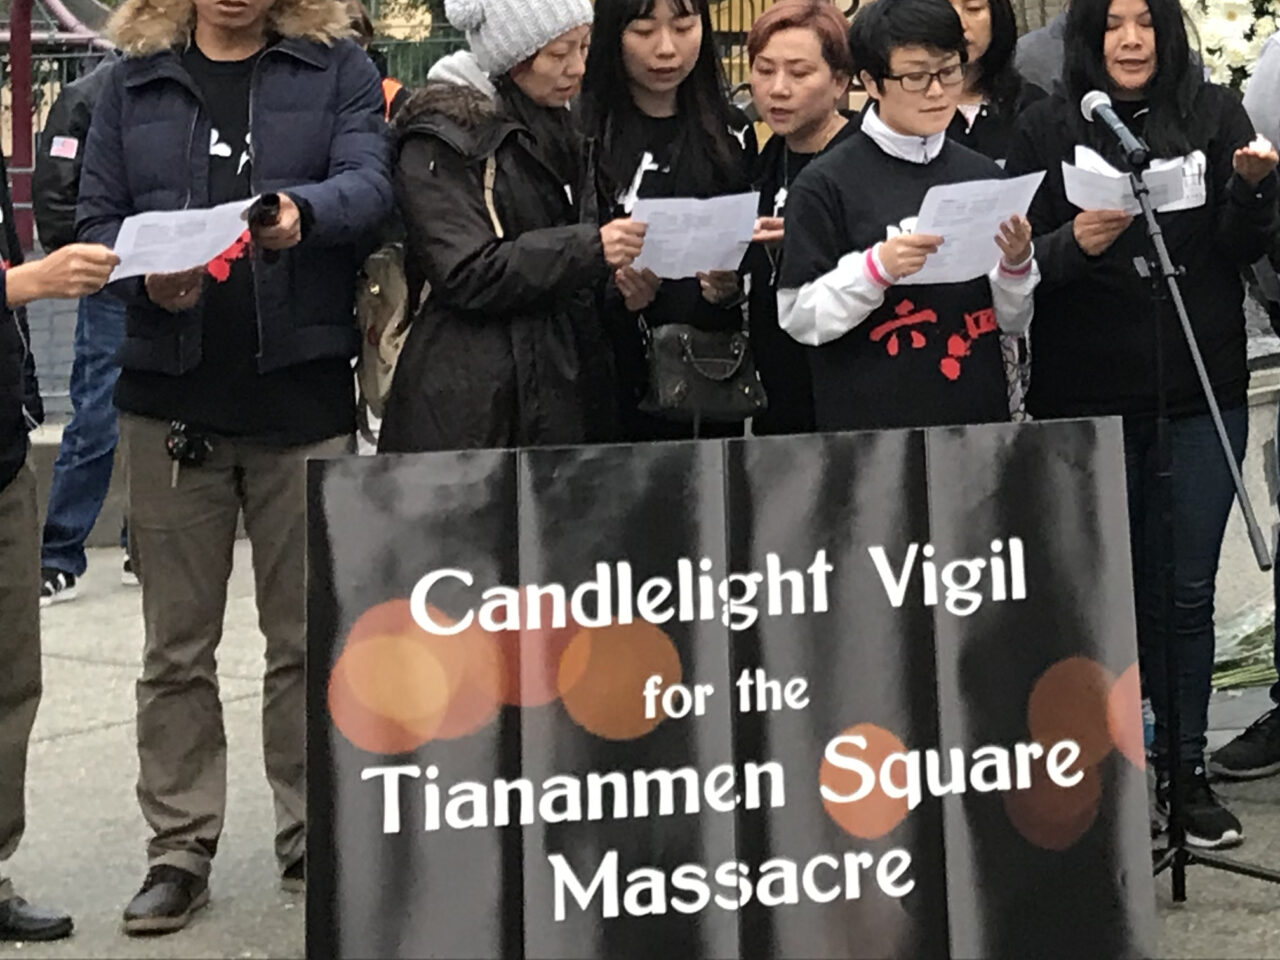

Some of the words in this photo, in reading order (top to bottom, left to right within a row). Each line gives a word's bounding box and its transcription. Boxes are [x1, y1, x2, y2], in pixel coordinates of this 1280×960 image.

[409, 548, 833, 637] Candlelight
[868, 537, 1028, 621] Vigil
[642, 674, 714, 720] for
[736, 668, 810, 713] the
[360, 758, 786, 835] Tiananmen
[818, 732, 1085, 812] Square
[547, 846, 916, 922] Massacre
